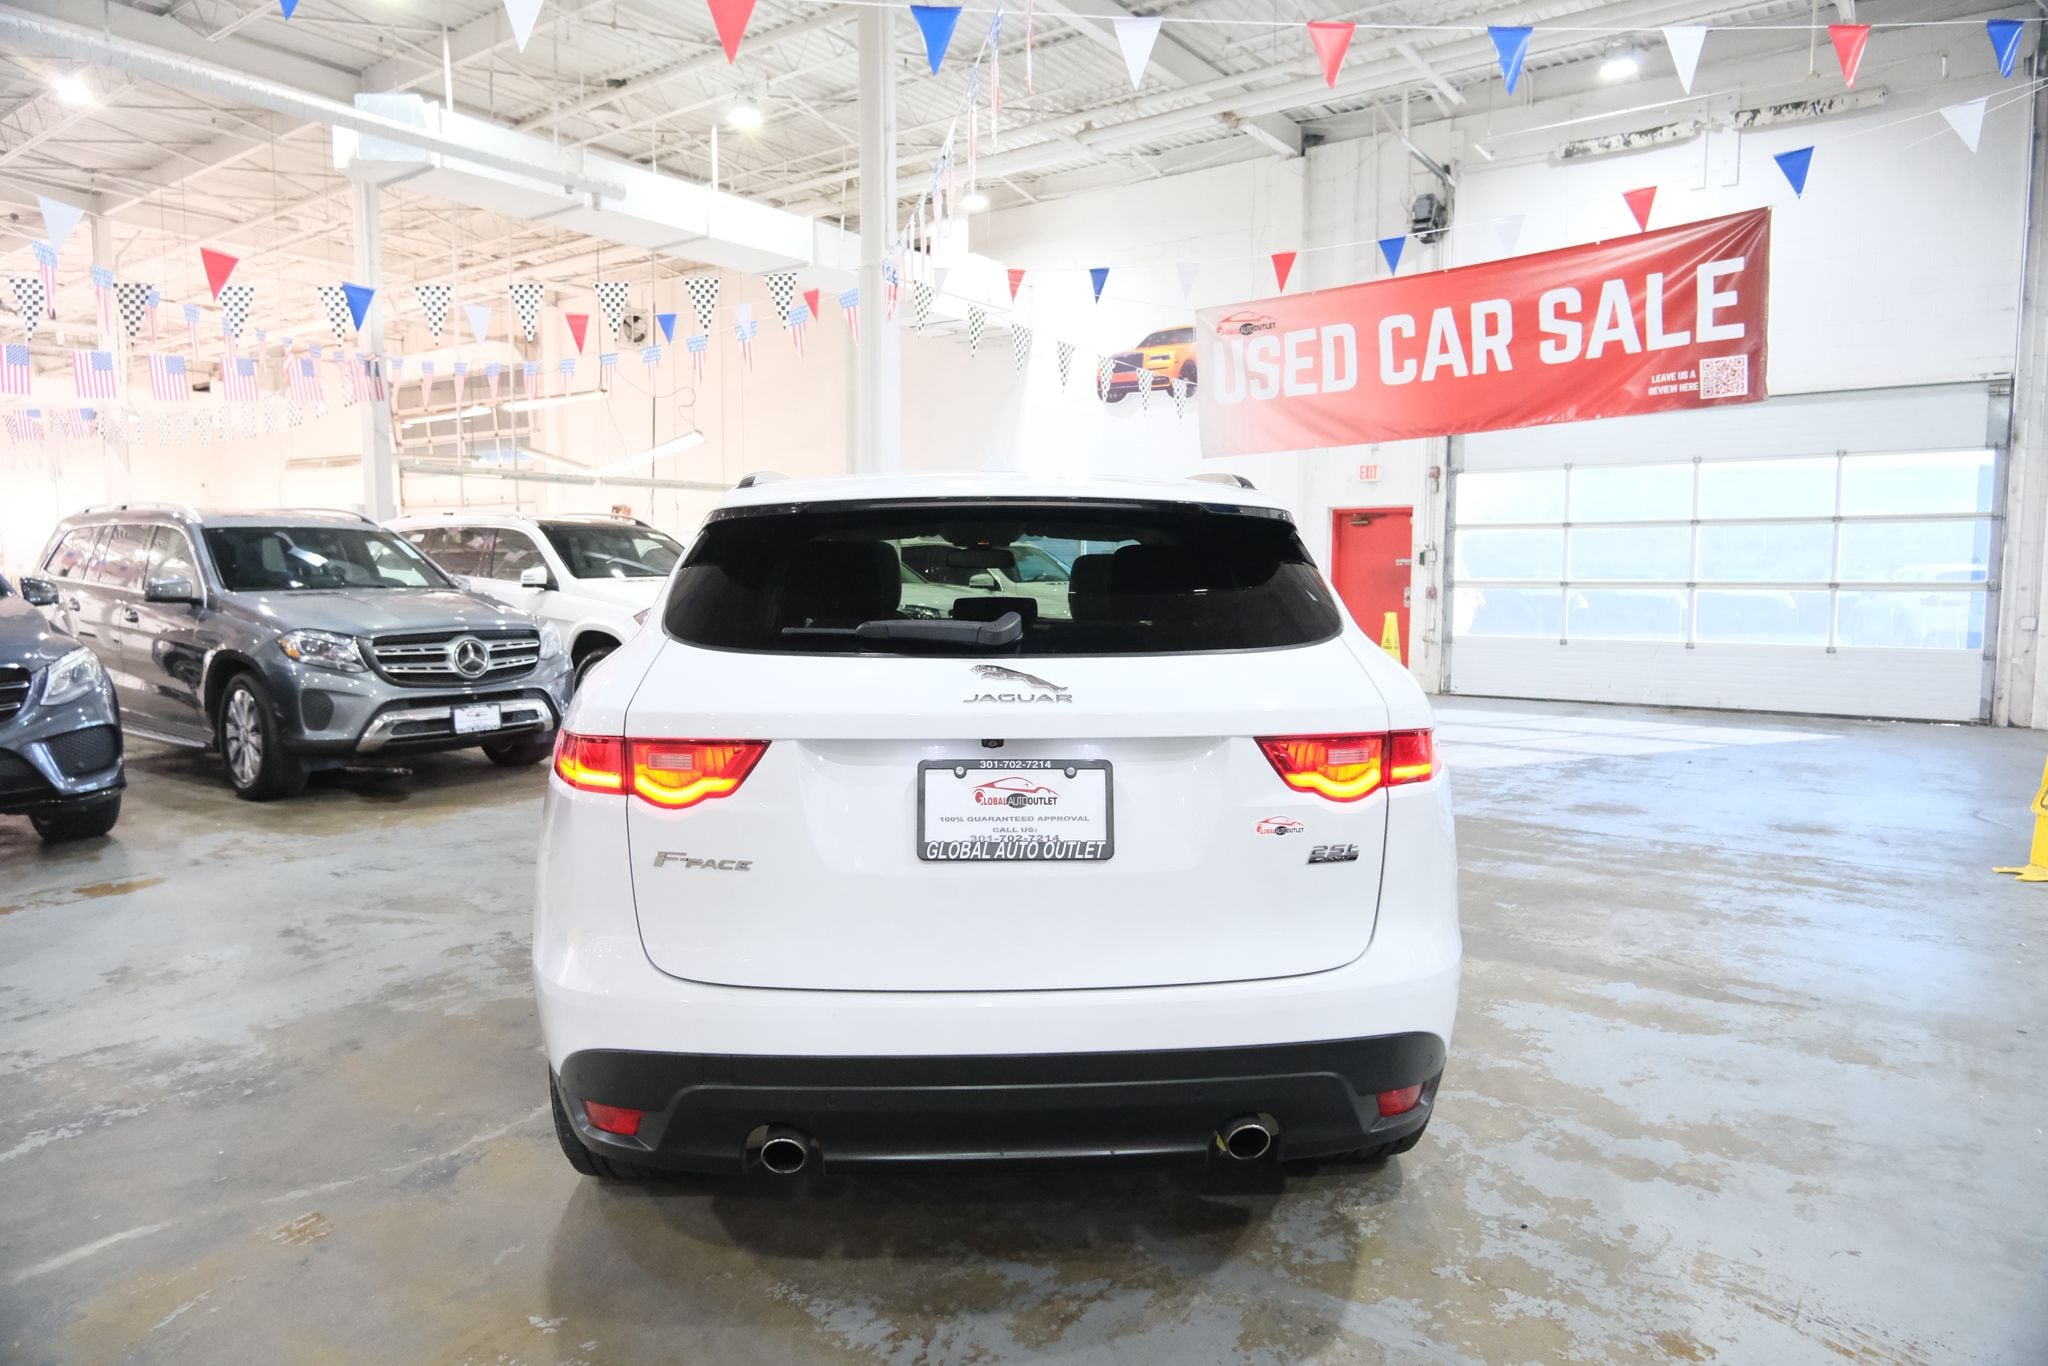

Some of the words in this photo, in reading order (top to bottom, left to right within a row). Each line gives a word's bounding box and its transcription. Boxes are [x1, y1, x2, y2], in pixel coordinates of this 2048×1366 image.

[1213, 323, 1359, 405] USED
[1378, 299, 1513, 386] CAR
[1538, 257, 1747, 365] SALE
[1651, 372, 1676, 383] LEAVE
[1678, 371, 1688, 380] US
[1690, 370, 1696, 379] A
[1648, 384, 1678, 396] REVIEW
[1680, 382, 1699, 392] HERE
[1360, 465, 1378, 480] EXIT
[962, 693, 1073, 704] JAGUAR
[980, 760, 1052, 769] 301-702-7214
[970, 834, 1060, 842] 301-702-7214
[926, 841, 991, 860] GLOBAL
[994, 841, 1039, 860] AUTO
[1043, 841, 1106, 860] OUTLET
